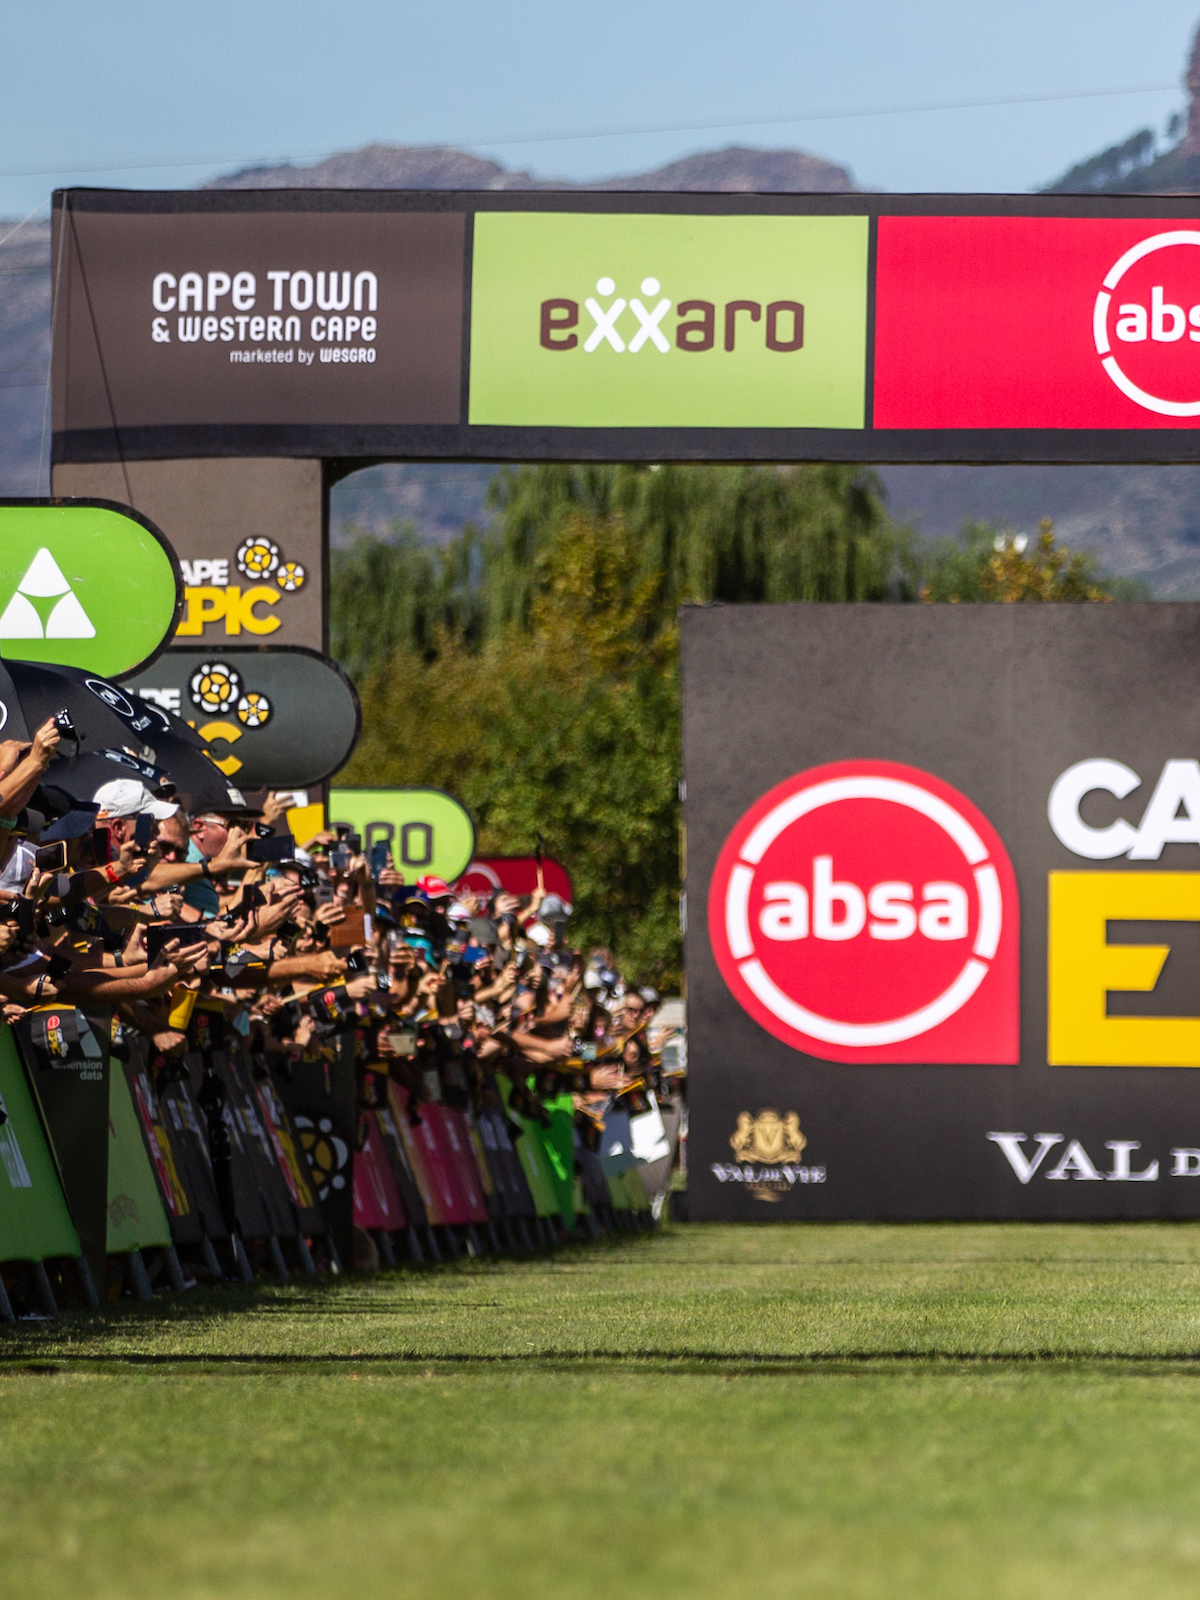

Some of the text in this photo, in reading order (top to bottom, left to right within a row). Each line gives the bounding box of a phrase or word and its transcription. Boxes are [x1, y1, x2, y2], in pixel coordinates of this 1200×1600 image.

[151, 316, 171, 342] &
[540, 277, 804, 353] exxaro
[229, 349, 293, 364] marketed
[297, 348, 315, 367] by
[179, 559, 229, 586] APE
[175, 585, 282, 636] PIC
[758, 855, 969, 942] absa
[986, 1131, 1160, 1185] VAL
